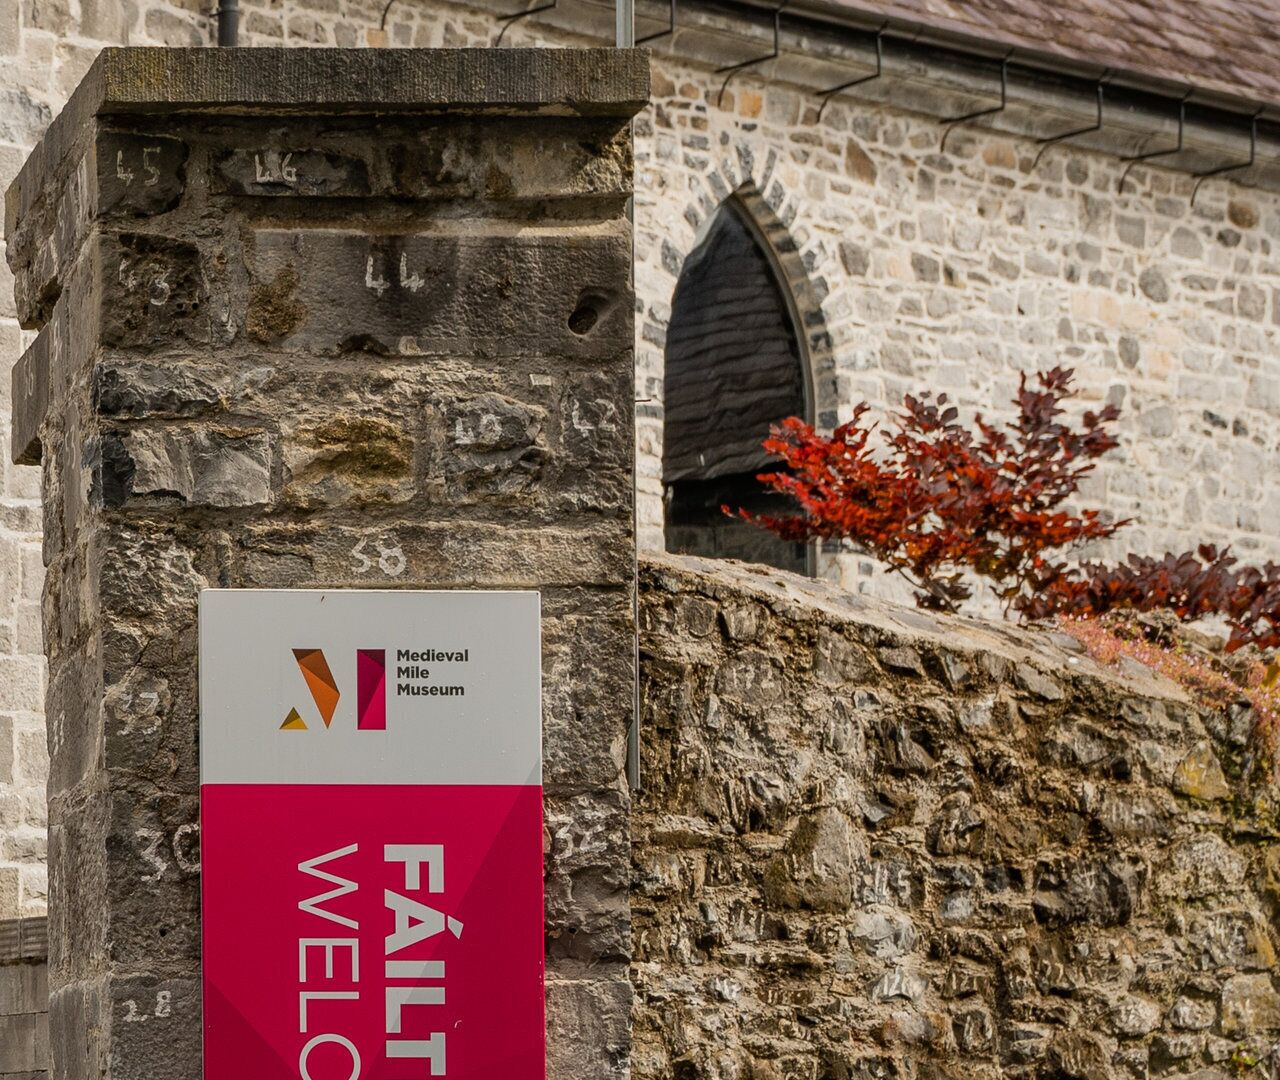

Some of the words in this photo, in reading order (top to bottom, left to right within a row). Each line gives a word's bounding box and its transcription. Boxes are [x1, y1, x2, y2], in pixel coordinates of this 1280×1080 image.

[116, 147, 161, 187] 45
[365, 252, 425, 297] 44
[396, 648, 470, 663] Medieval
[396, 665, 430, 679] Mile
[396, 683, 465, 697] Museum
[122, 990, 171, 1022] 28
